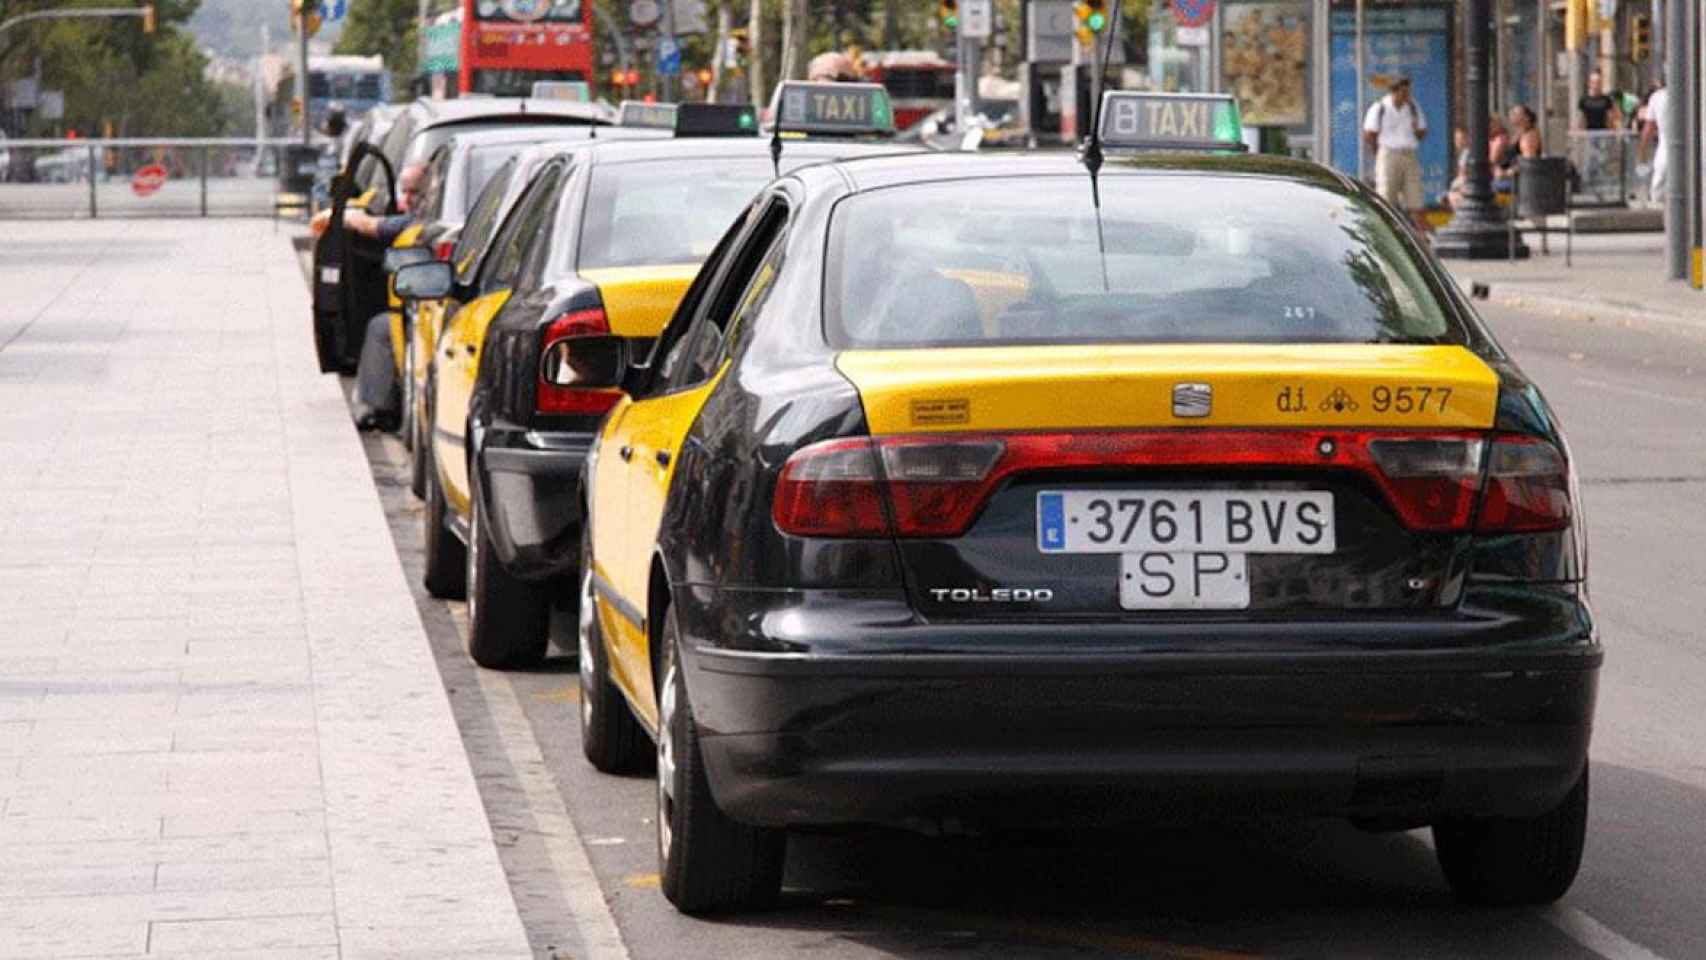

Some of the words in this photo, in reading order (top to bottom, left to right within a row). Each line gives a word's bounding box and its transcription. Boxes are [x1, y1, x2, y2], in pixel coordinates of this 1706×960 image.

[814, 94, 865, 120] TAXI
[1145, 101, 1209, 136] TAXI
[1371, 385, 1453, 413] 9577
[1087, 499, 1203, 544] 3761
[1225, 499, 1323, 545] BVS
[929, 588, 1053, 602] TOLEDO
